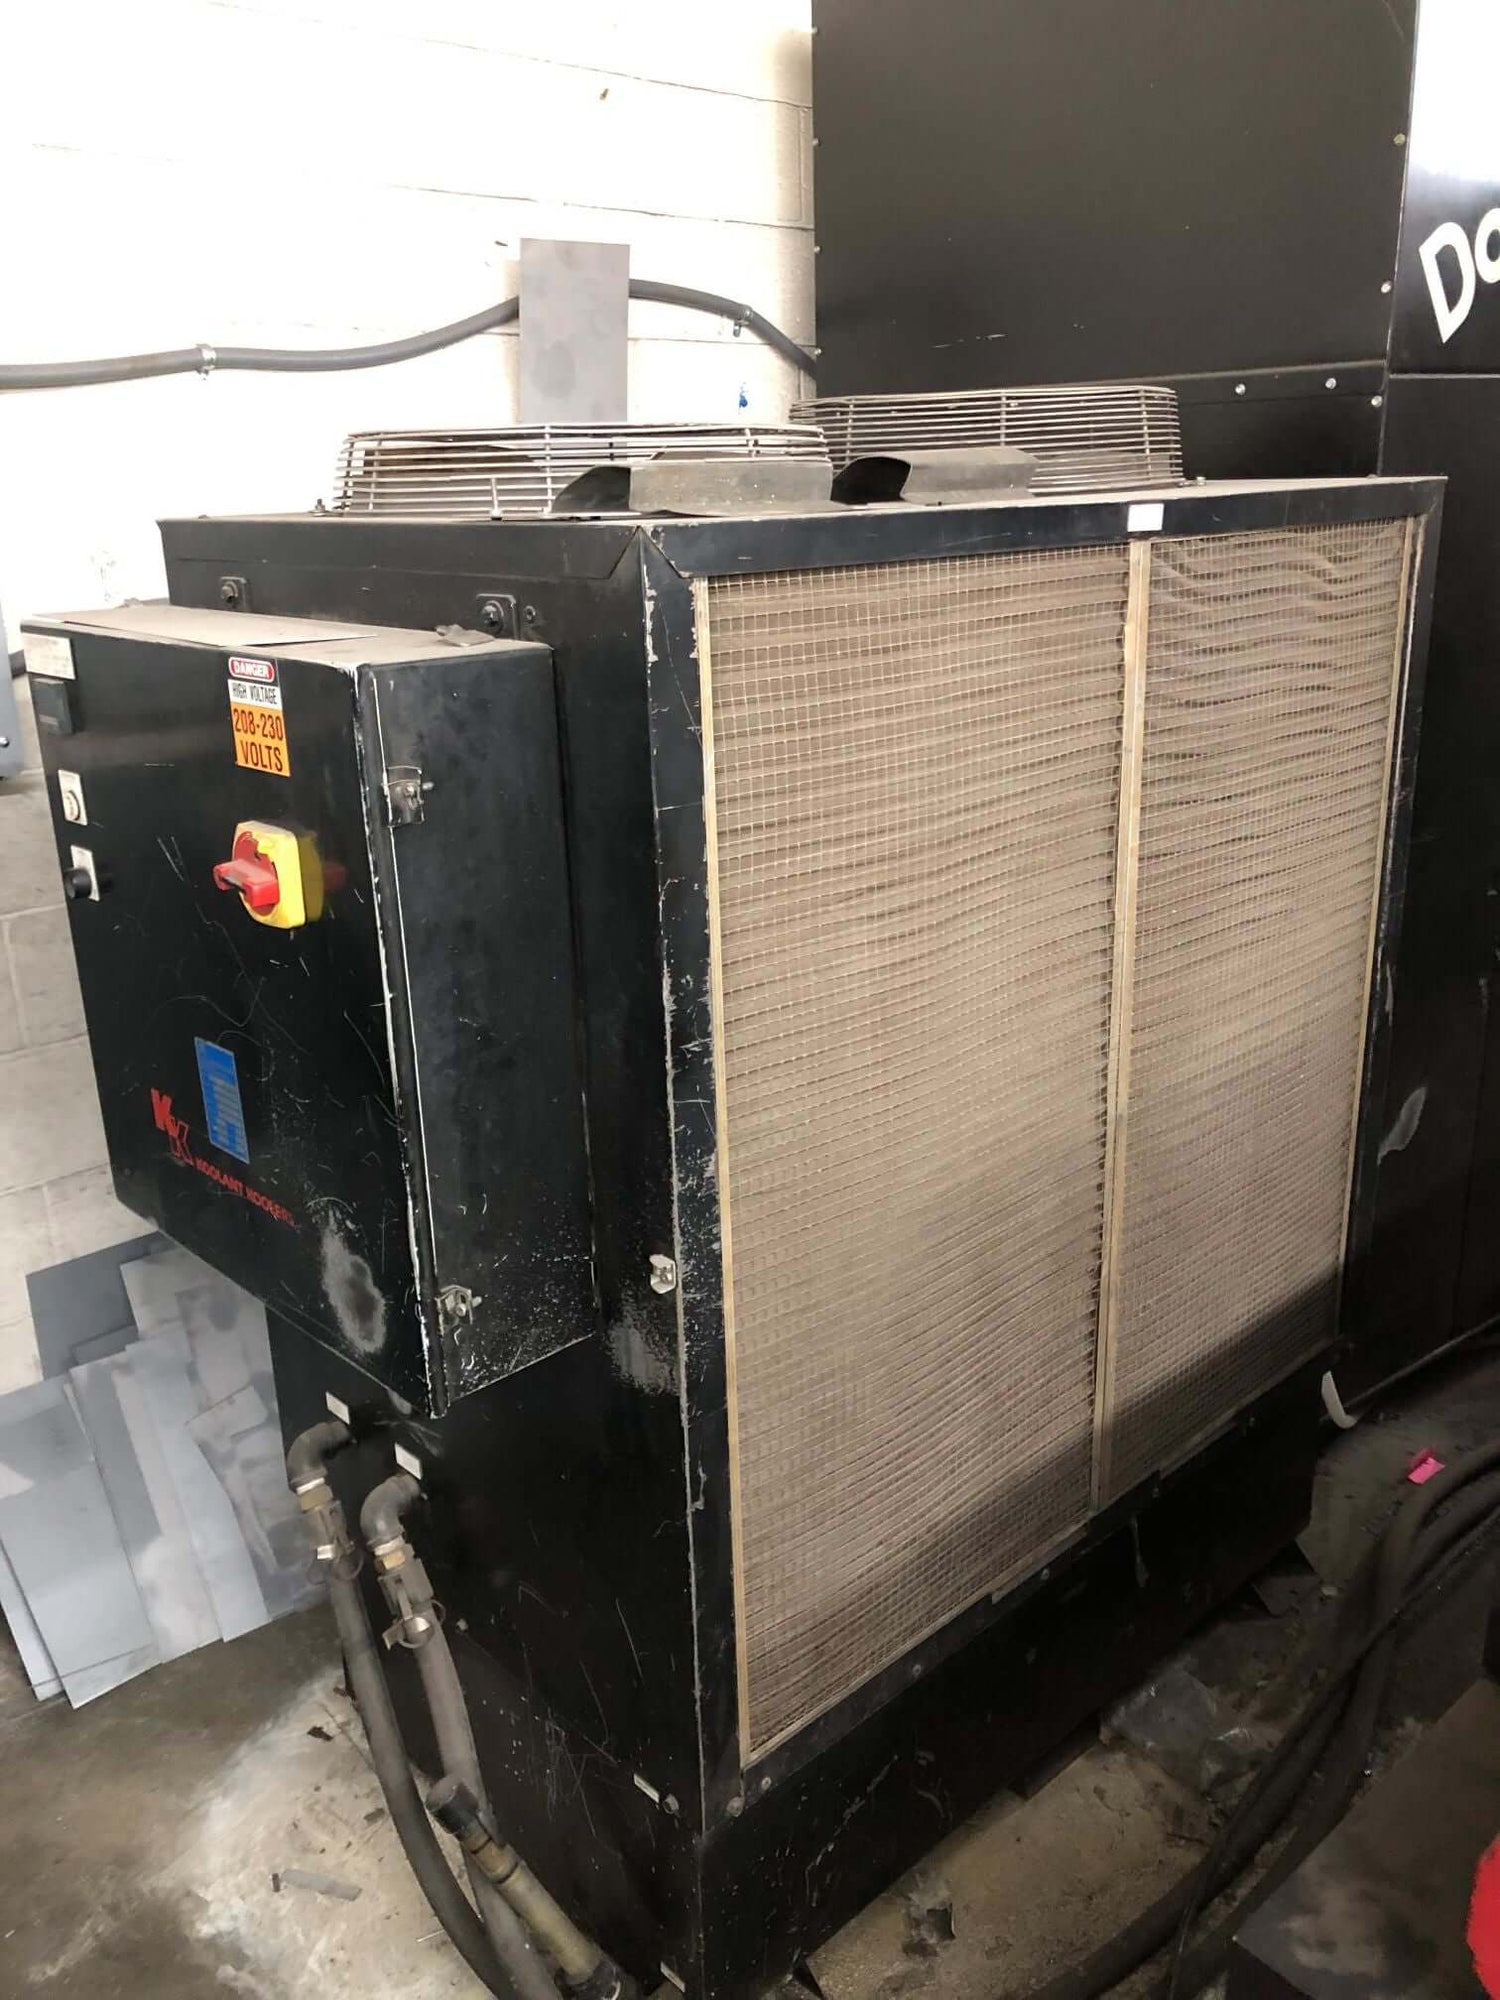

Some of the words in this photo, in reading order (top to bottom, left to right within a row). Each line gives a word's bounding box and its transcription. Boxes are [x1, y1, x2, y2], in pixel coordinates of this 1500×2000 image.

[232, 660, 270, 679] DANGER
[231, 682, 247, 699] HIGH
[249, 685, 277, 705] VOLTAGE
[233, 708, 284, 741] 208-230
[240, 740, 283, 772] VOLTS
